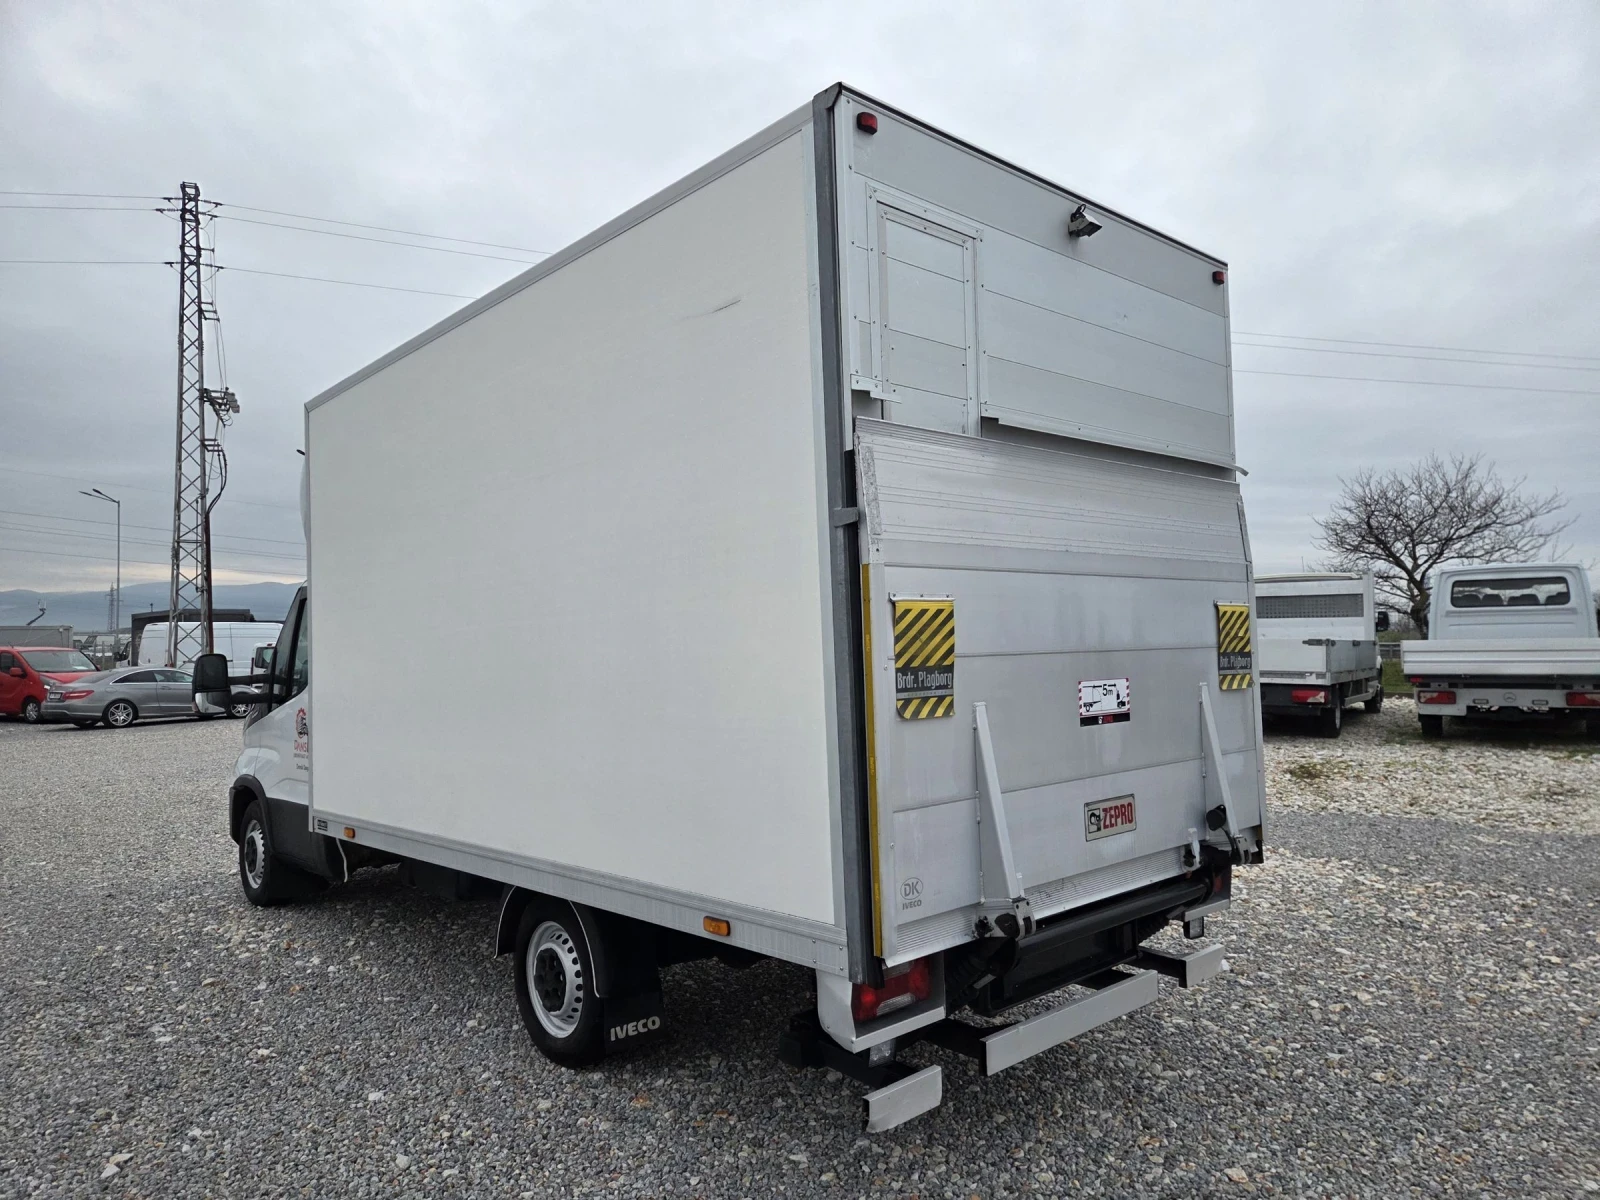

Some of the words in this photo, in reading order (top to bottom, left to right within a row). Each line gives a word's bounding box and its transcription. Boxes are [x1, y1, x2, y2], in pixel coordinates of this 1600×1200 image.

[897, 672, 917, 689] Brdr.
[918, 670, 952, 689] Plagborg
[1102, 683, 1114, 697] 5m
[1102, 802, 1134, 830] ZEPRO
[903, 881, 920, 897] DK
[902, 899, 922, 911] IVECO
[610, 1016, 660, 1041] IVECO
